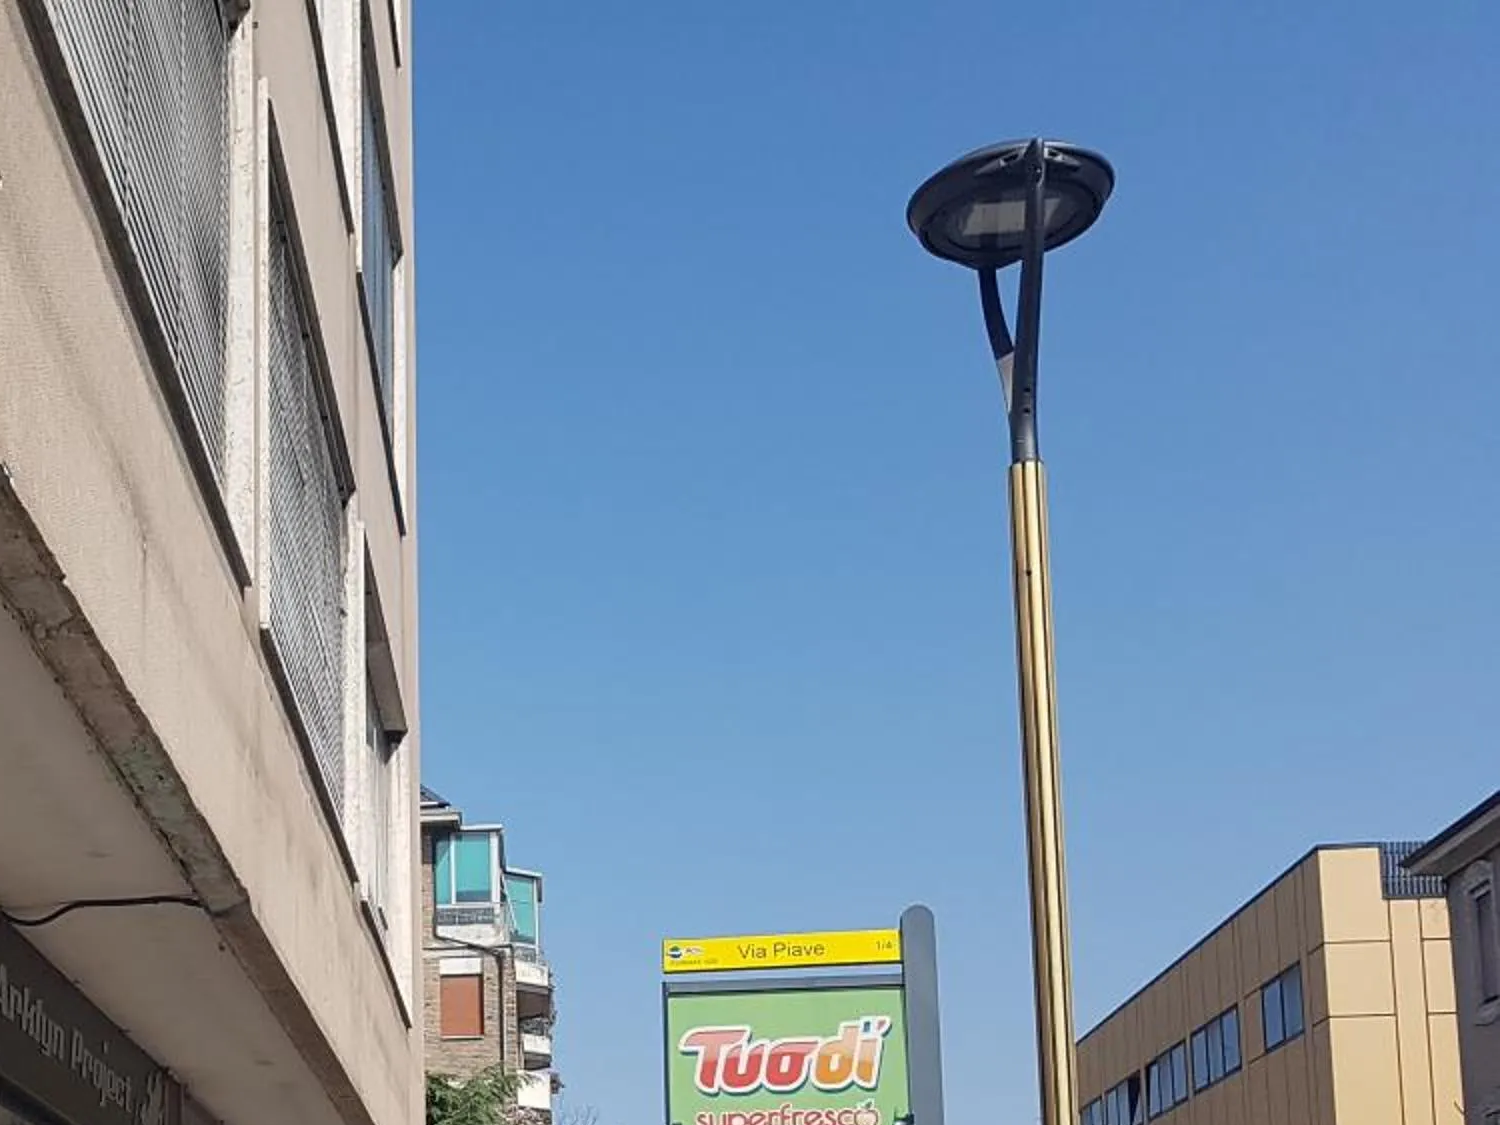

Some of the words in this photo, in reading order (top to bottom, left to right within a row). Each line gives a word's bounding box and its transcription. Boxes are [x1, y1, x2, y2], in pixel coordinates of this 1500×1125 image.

[736, 943, 767, 959] Via
[773, 941, 825, 957] Piave
[71, 1026, 132, 1113] Project
